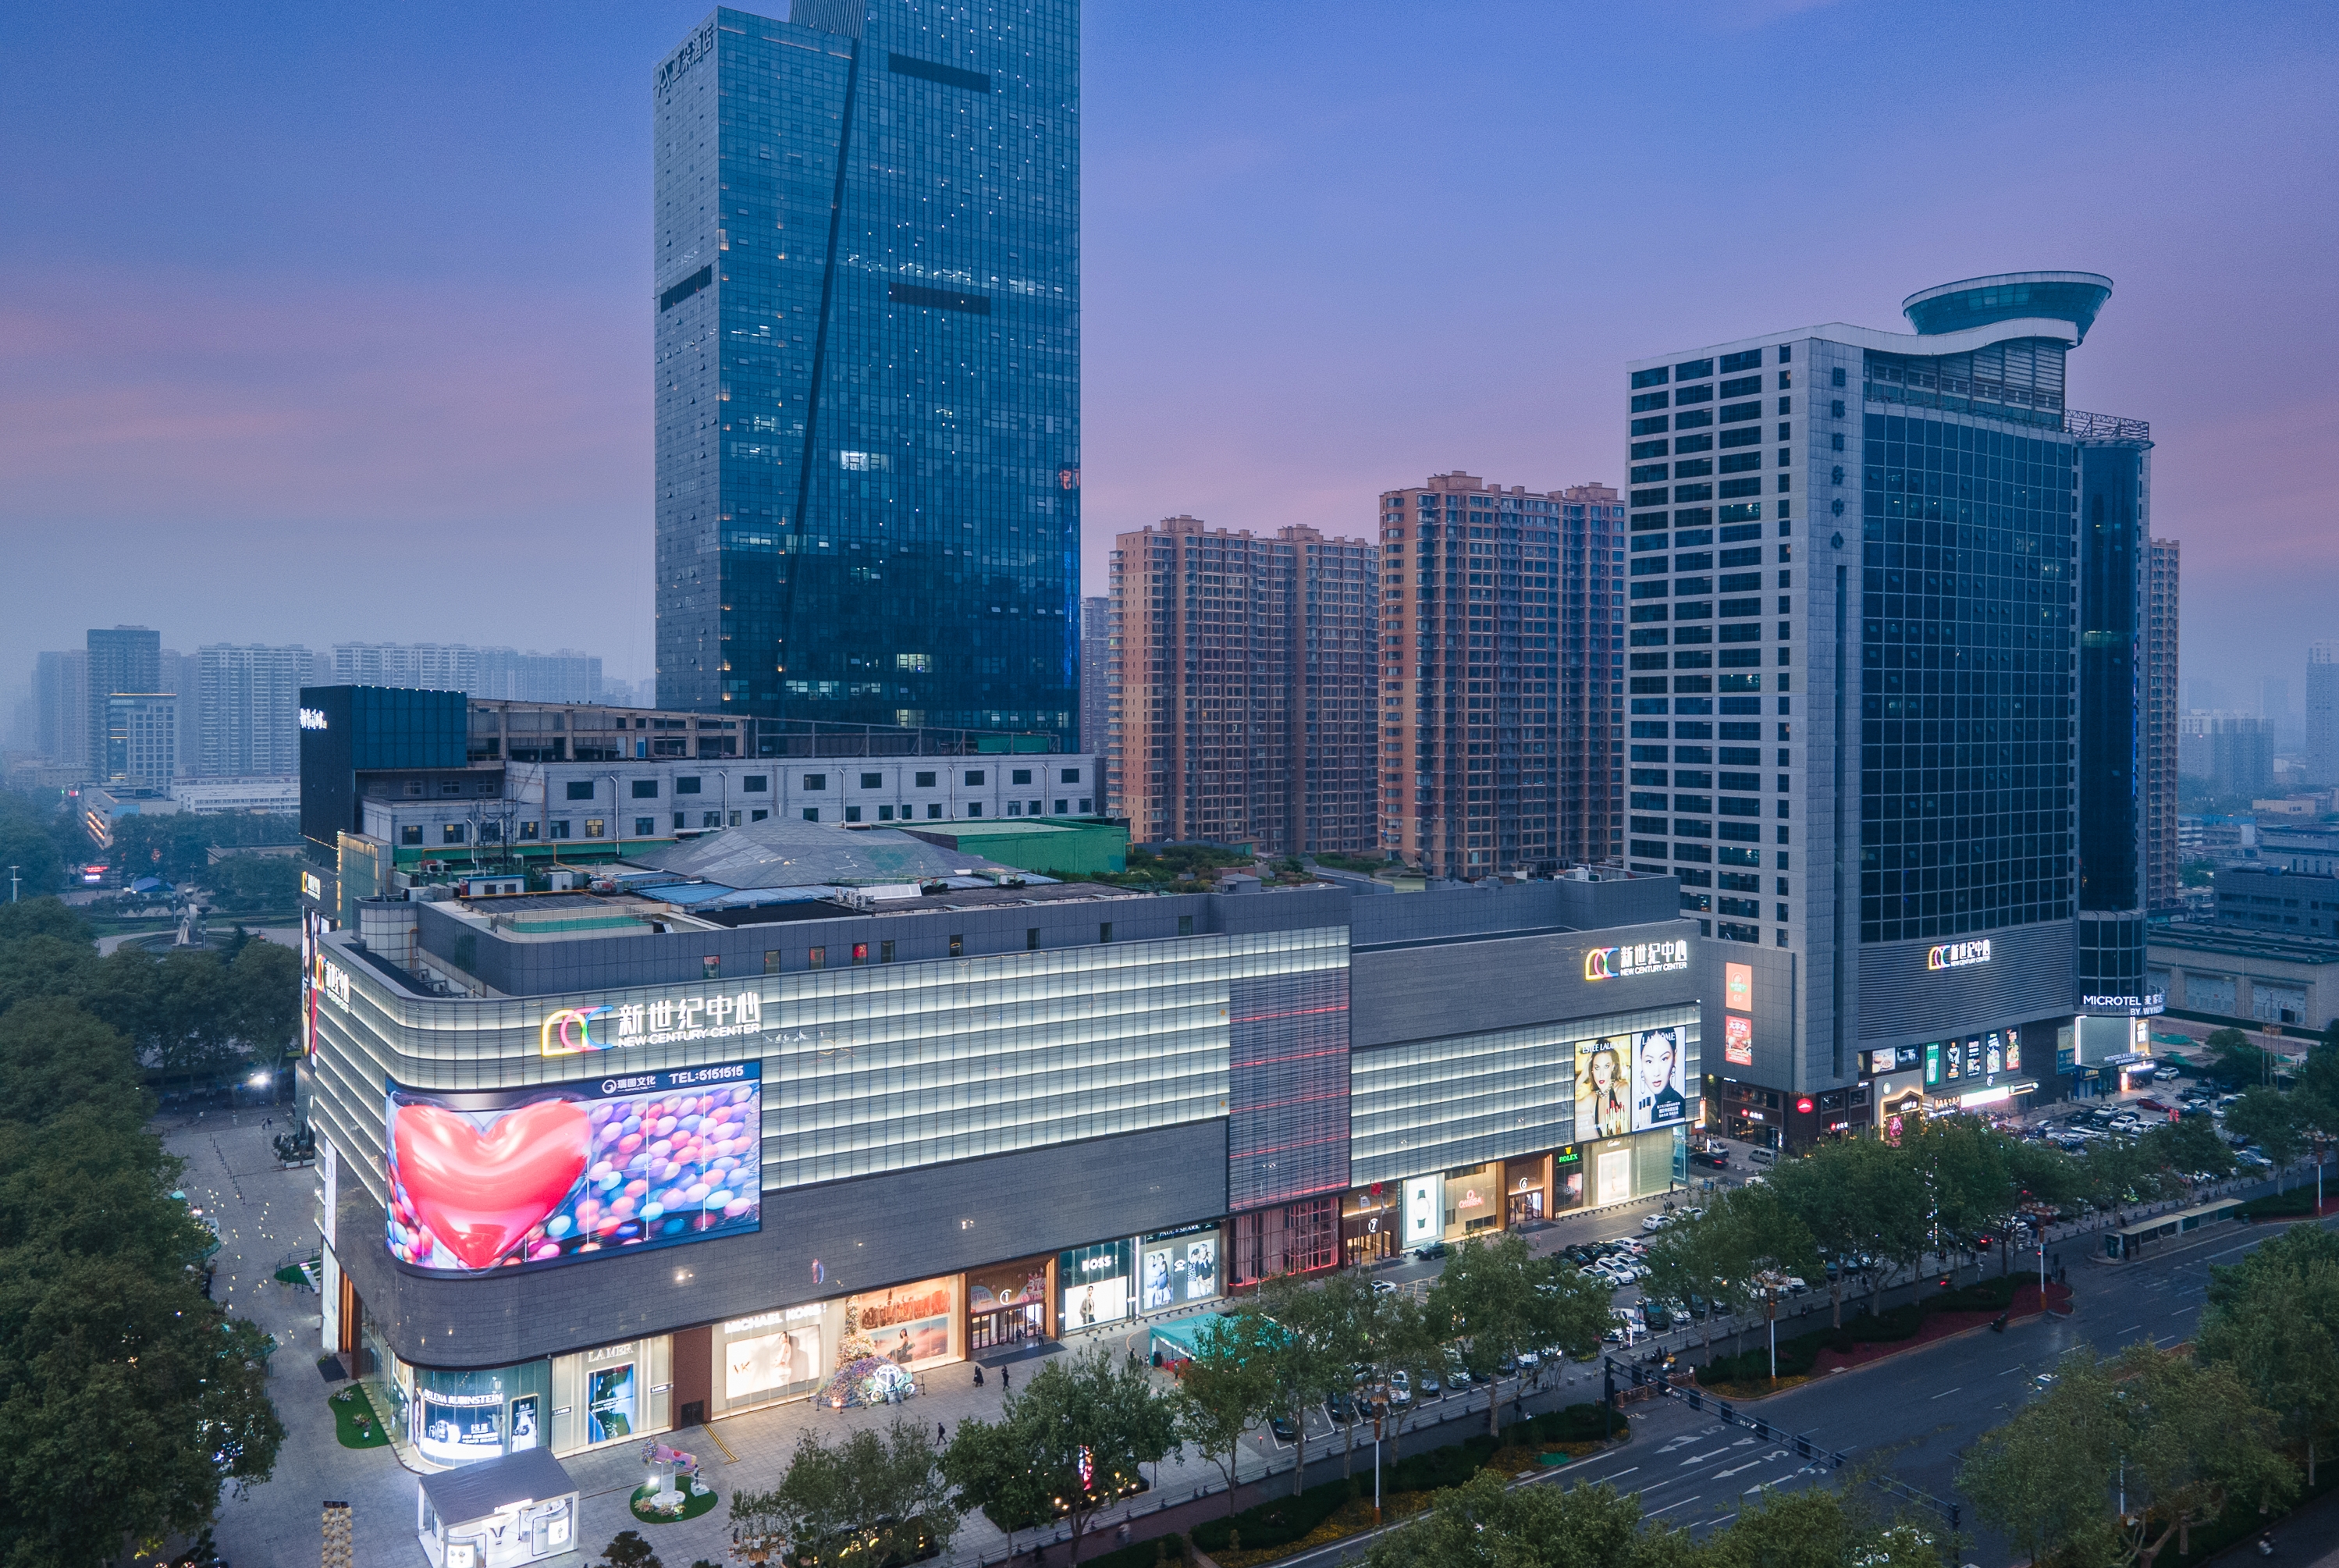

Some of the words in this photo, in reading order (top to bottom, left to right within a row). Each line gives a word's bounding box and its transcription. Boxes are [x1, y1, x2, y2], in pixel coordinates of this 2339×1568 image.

[672, 23, 713, 82] 亚朵酒店
[1831, 367, 1846, 549] 国际商务中心
[1620, 940, 1687, 968] 新世纪中心
[1635, 964, 1663, 974] CENTURY
[1663, 962, 1687, 971] CENTER
[2083, 995, 2142, 1006] MICROTEL
[618, 991, 760, 1036] 新世纪中心
[618, 1035, 649, 1047] NEW
[649, 1029, 707, 1044] CENTURY
[710, 1024, 759, 1038] CENTER
[669, 1065, 744, 1085] TEL:5151515
[1559, 1154, 1578, 1163] ROLEX
[1459, 1196, 1484, 1208] OMEGA
[1082, 1256, 1111, 1271] BOSS
[724, 1312, 783, 1334] MICHAEL
[786, 1303, 822, 1321] KORS
[588, 1351, 605, 1362] LA
[606, 1343, 633, 1359] MER
[448, 1392, 503, 1404] RUBINSTEIN
